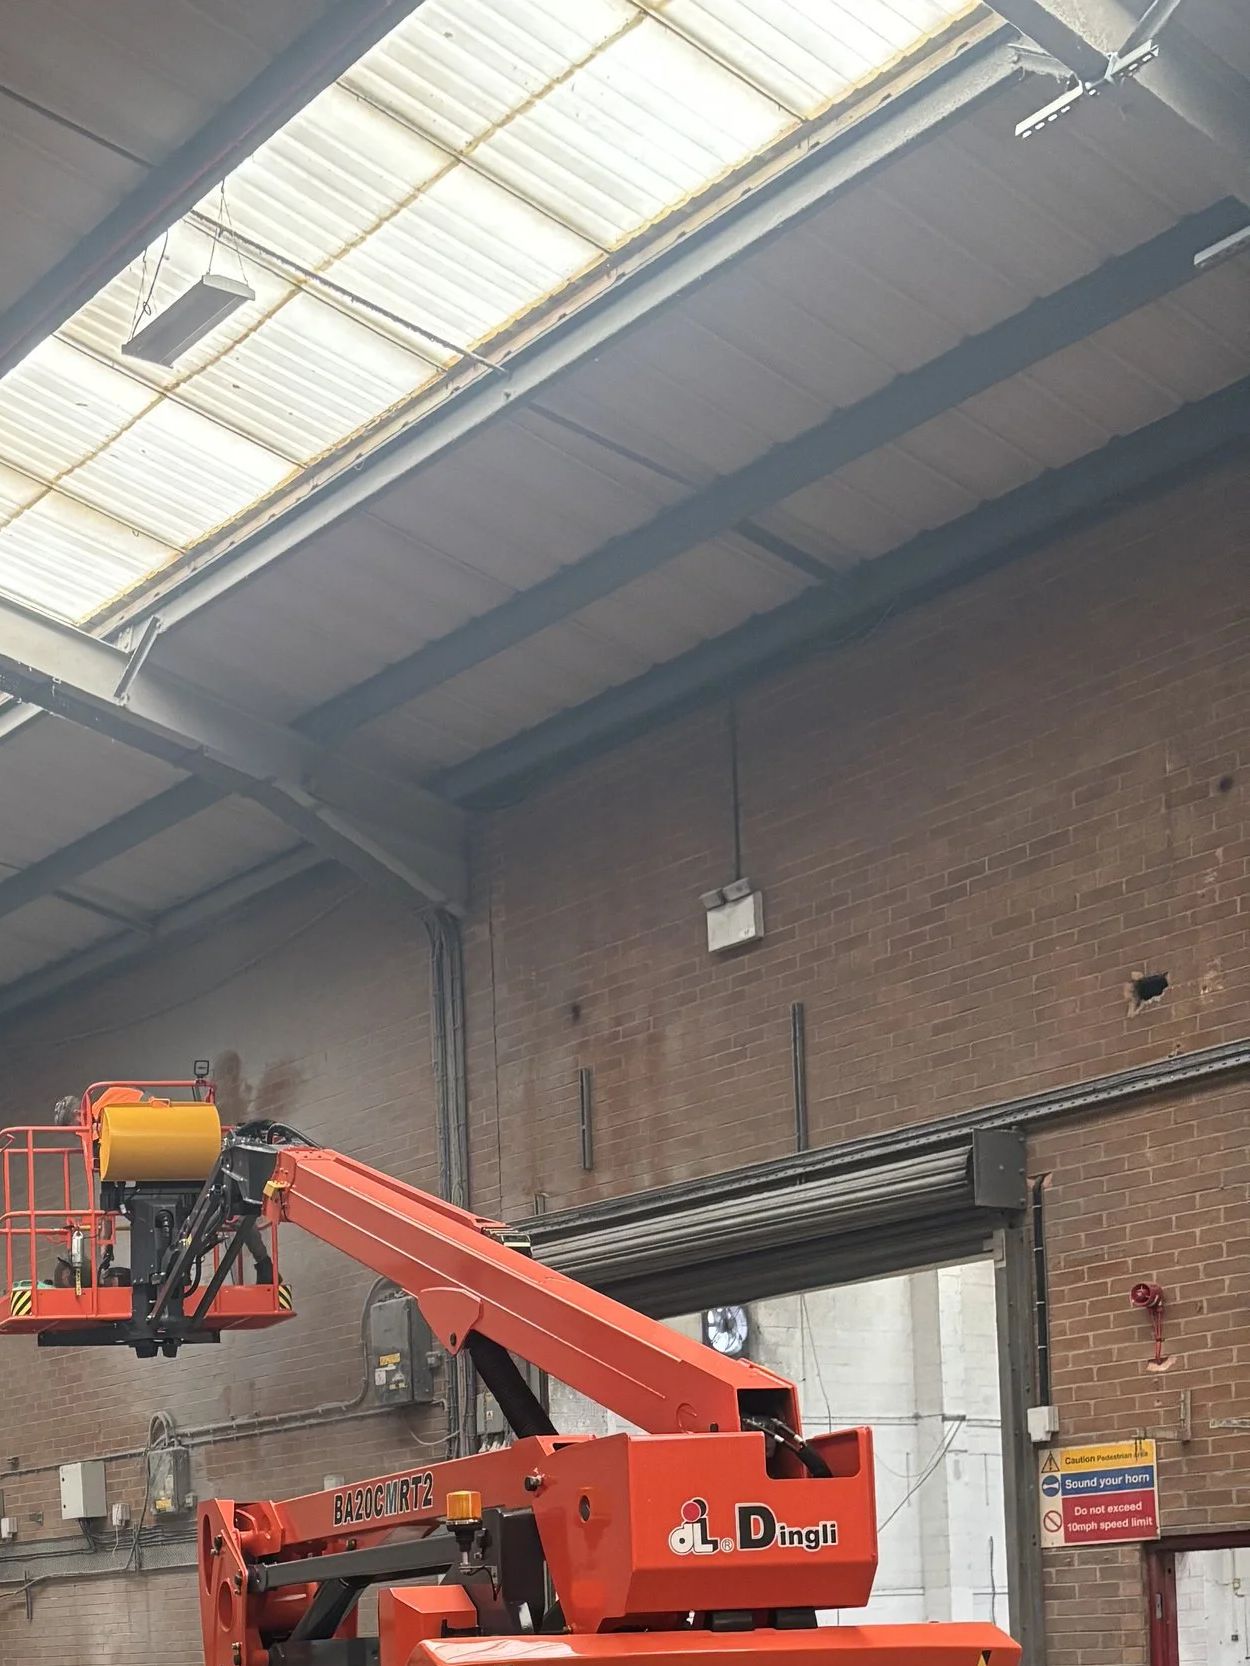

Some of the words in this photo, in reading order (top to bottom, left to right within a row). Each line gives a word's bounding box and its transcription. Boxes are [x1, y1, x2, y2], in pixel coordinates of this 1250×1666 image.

[1065, 1455, 1096, 1465] Caution
[1096, 1452, 1132, 1462] Pedestrian
[1065, 1477, 1097, 1489] Sound
[1099, 1476, 1123, 1488] your
[1125, 1473, 1150, 1484] horn
[333, 1471, 434, 1527] BA20CMRT2
[1074, 1506, 1088, 1516] Do
[1089, 1505, 1106, 1515] not
[1107, 1501, 1143, 1513] exceed
[735, 1502, 838, 1552] Dingli
[1067, 1521, 1098, 1533] 10mph
[1099, 1518, 1129, 1531] speed
[1131, 1517, 1153, 1528] limit
